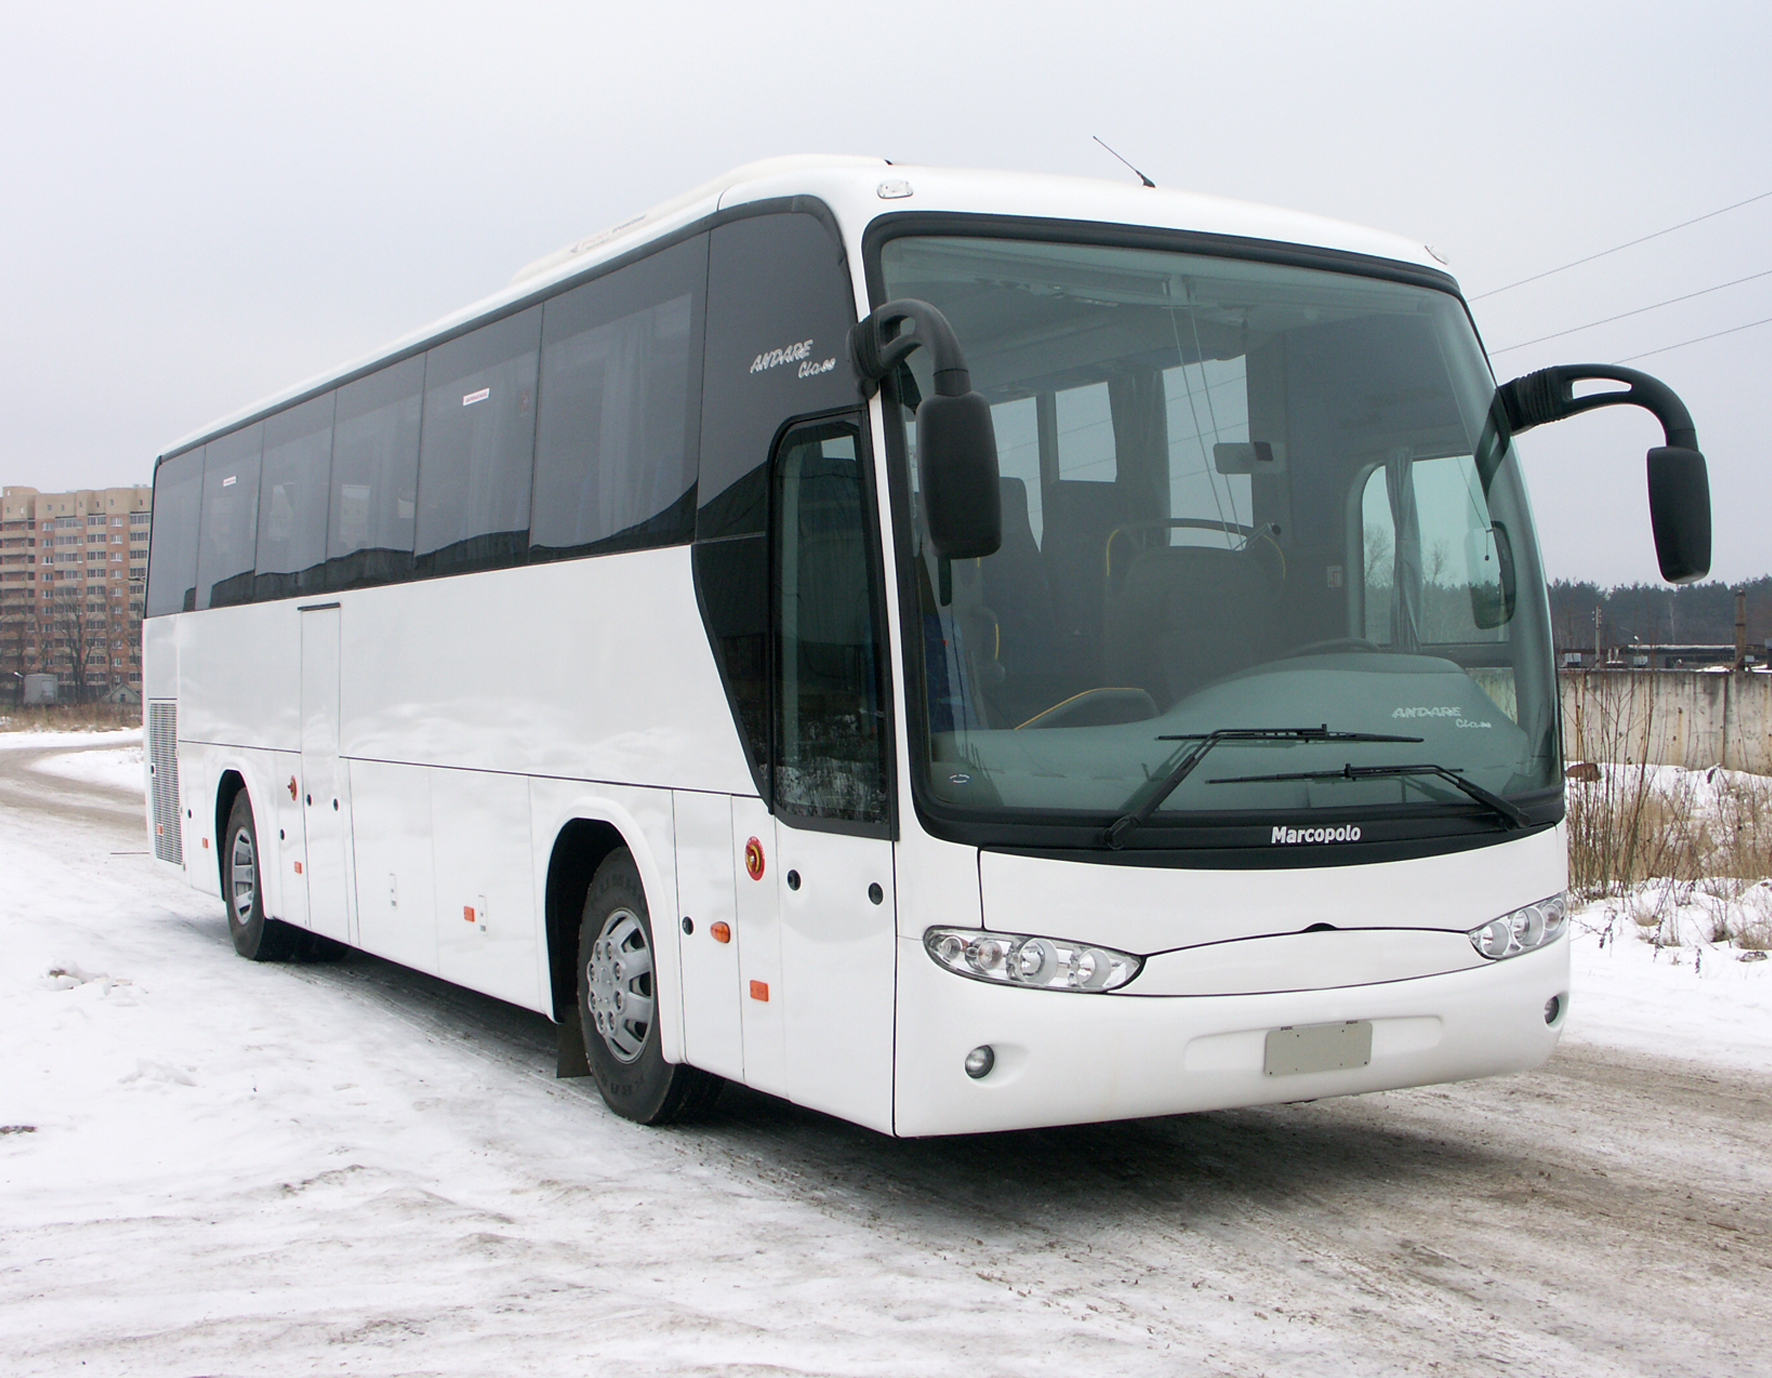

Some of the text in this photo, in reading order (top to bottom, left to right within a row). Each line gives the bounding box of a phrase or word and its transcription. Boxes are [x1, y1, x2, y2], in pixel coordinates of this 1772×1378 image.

[749, 339, 813, 374] ANDARE
[1391, 706, 1462, 719] ANDARE
[1271, 824, 1362, 844] Marcopolo
